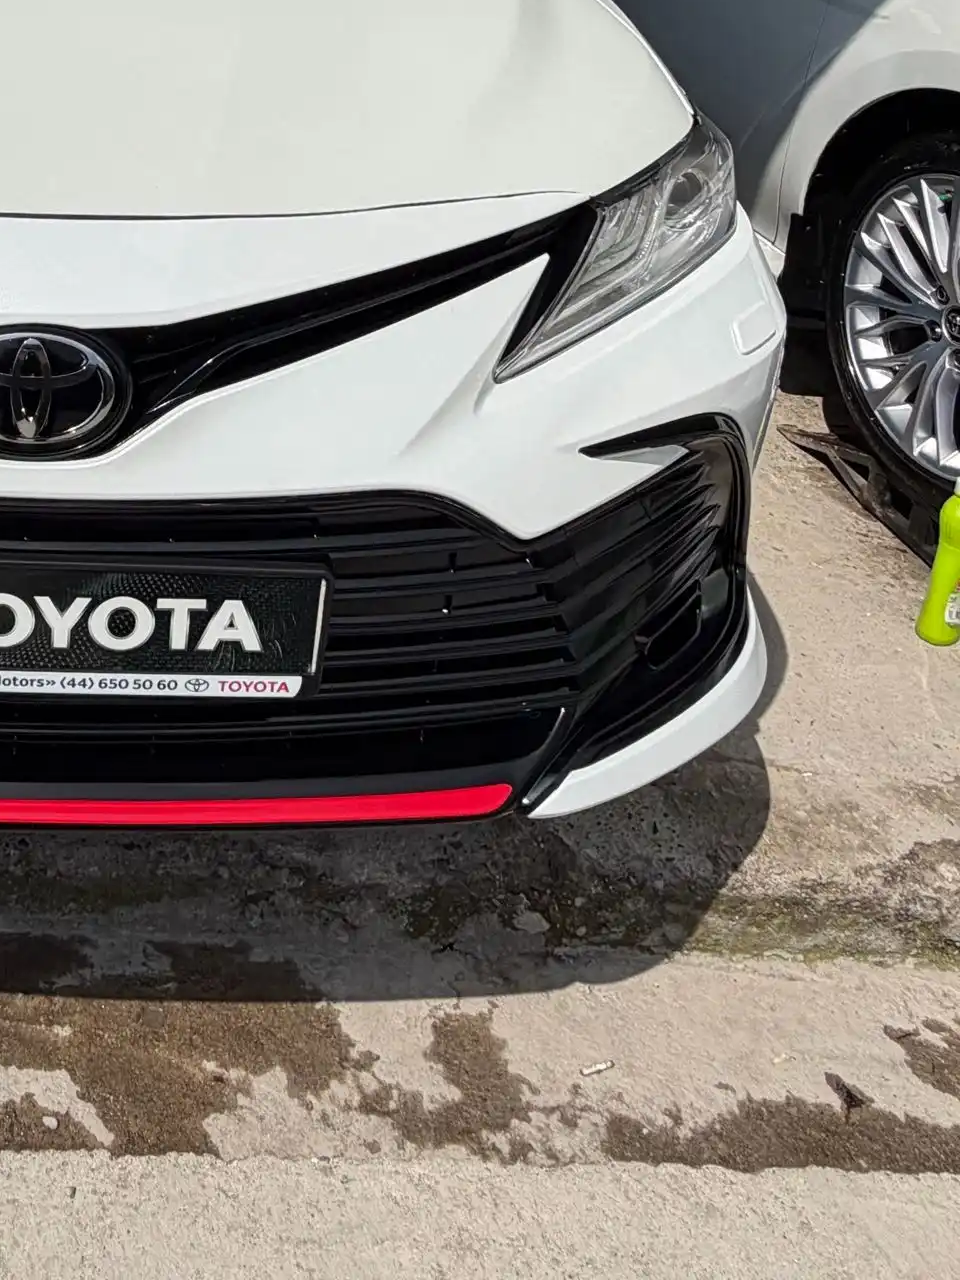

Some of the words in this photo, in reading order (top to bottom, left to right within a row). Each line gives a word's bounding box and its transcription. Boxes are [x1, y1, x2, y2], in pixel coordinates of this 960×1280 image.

[59, 676, 94, 690] (44)
[98, 677, 129, 690] 650
[132, 679, 153, 691] 50
[156, 679, 179, 691] 60
[218, 680, 290, 693] TOYOTA
